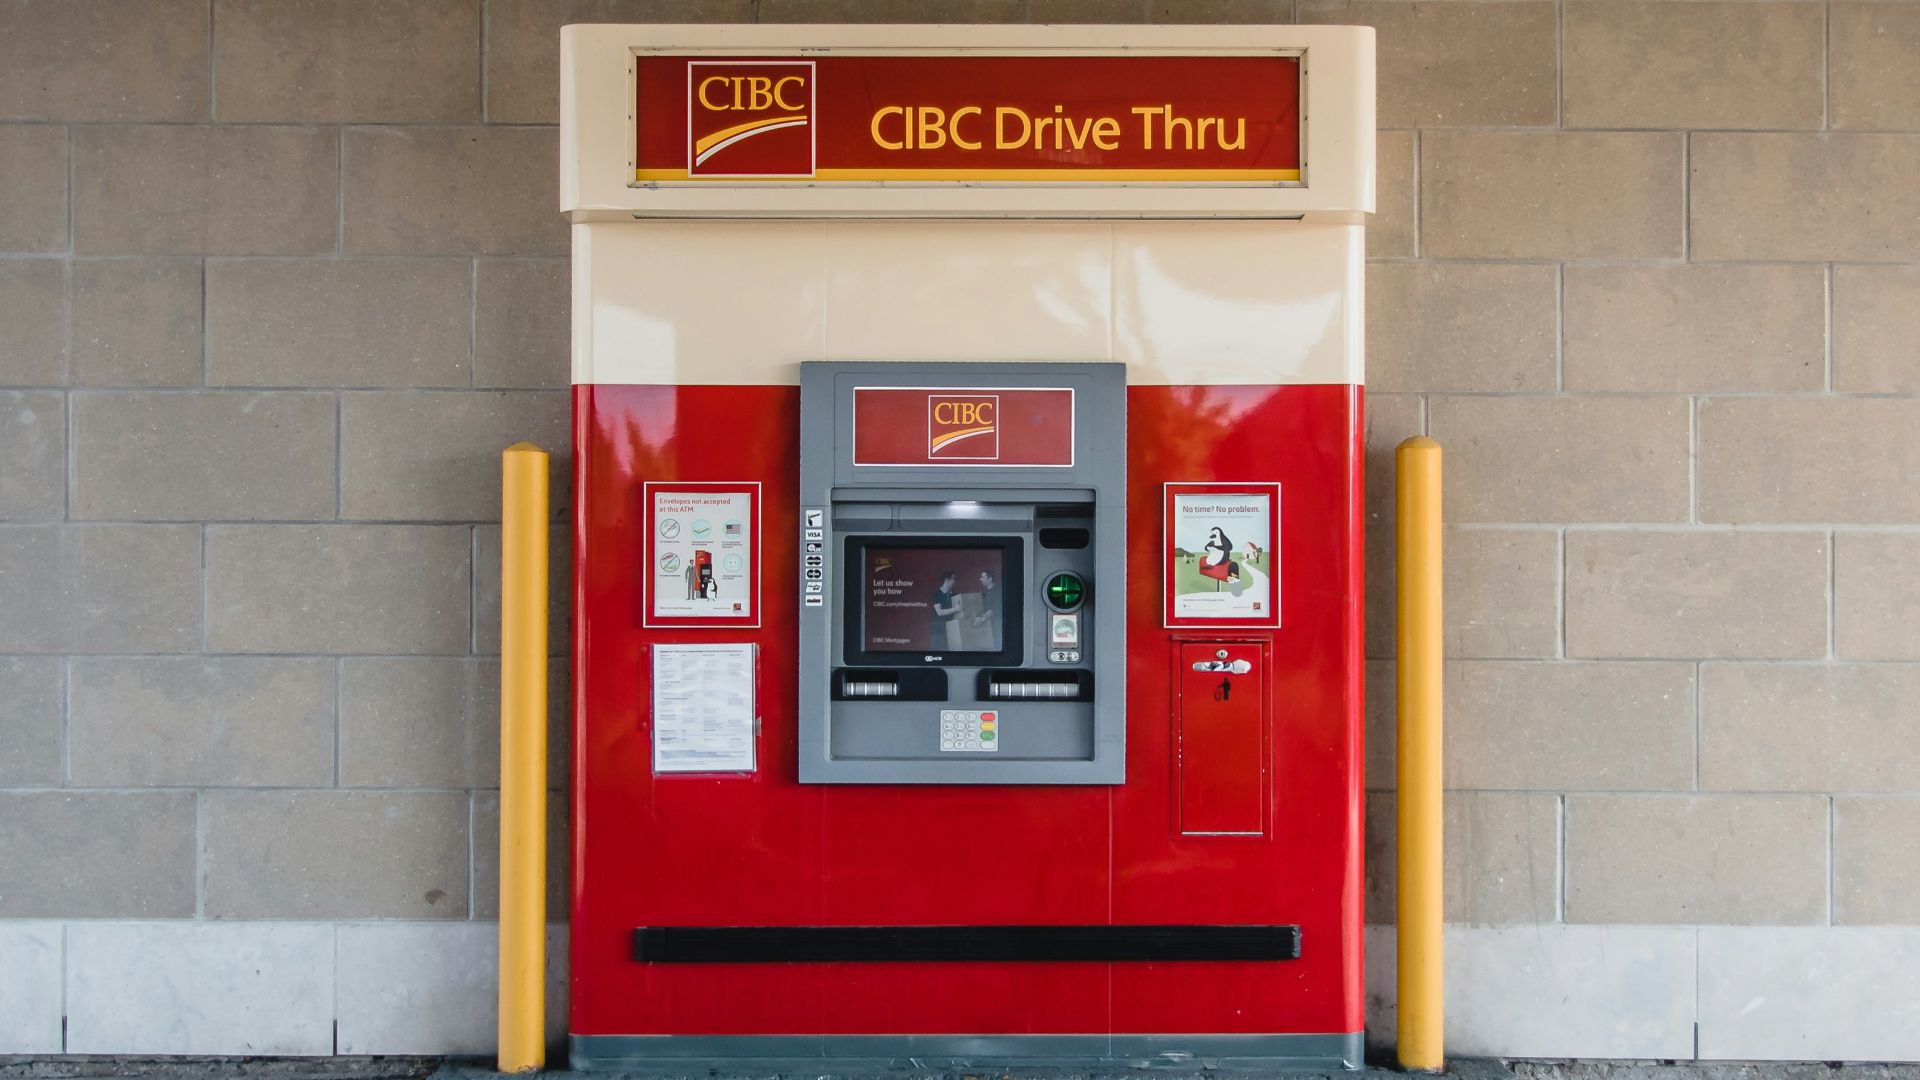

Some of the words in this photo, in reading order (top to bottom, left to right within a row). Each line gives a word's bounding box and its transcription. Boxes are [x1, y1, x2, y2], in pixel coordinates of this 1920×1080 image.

[698, 76, 805, 111] CIBC
[870, 106, 982, 150] CIBC
[995, 105, 1121, 151] Drive
[1131, 105, 1245, 151] Thru
[934, 402, 993, 425] CIBC
[659, 498, 690, 506] Envelopes
[703, 498, 731, 506] accepted
[1182, 505, 1194, 513] No
[1194, 505, 1214, 513] time?
[1216, 505, 1227, 513] No
[1228, 505, 1260, 514] problem.
[873, 579, 884, 587] Let
[895, 579, 914, 587] show
[873, 588, 886, 596] you
